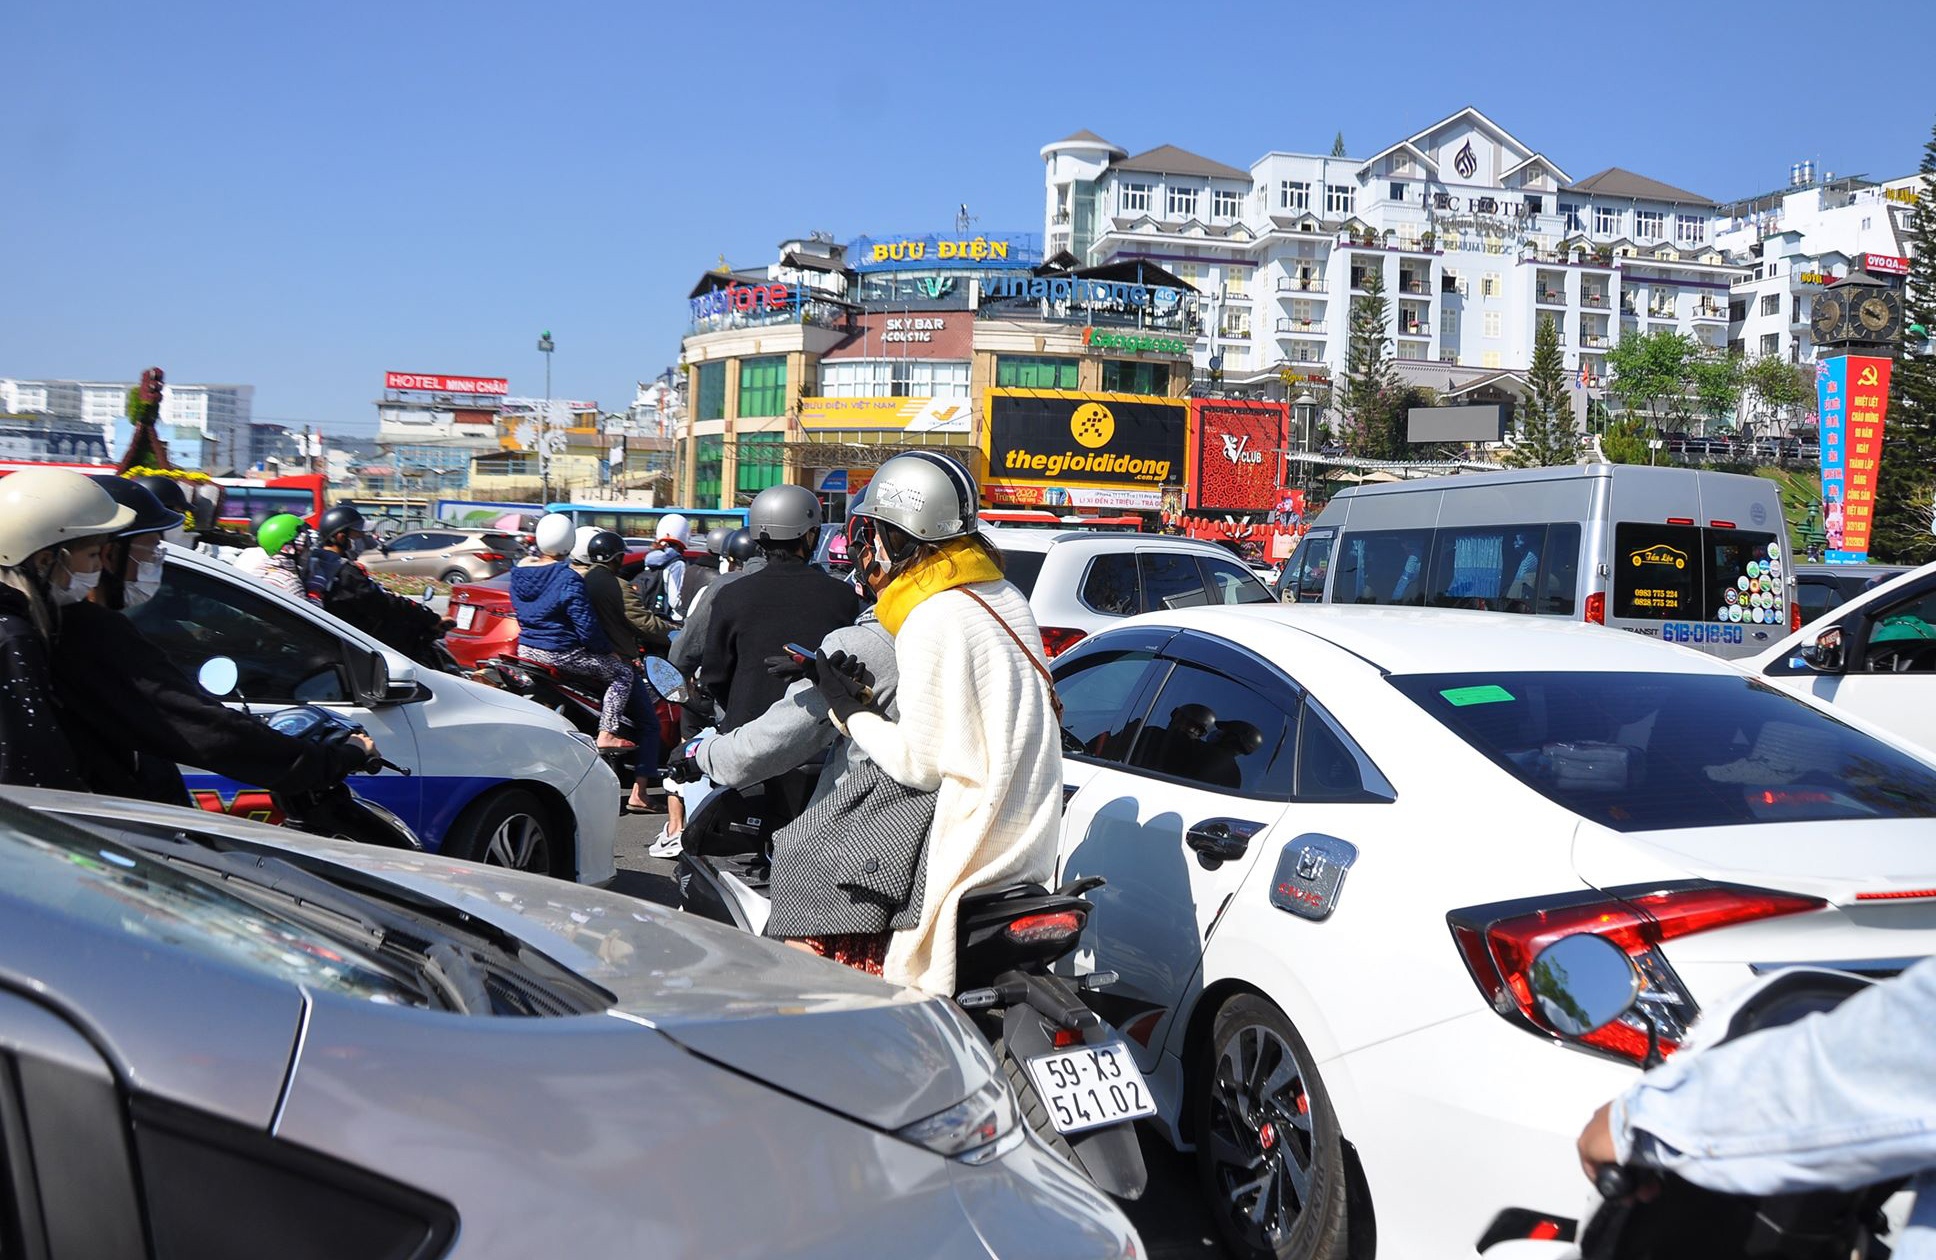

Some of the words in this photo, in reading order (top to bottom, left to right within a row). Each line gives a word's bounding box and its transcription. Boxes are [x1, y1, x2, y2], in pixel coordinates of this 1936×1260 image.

[873, 241, 925, 262] BƯU
[937, 236, 1009, 262] ĐIỆN
[1868, 256, 1886, 267] OYO
[981, 275, 1147, 306] vinaphone
[1157, 290, 1173, 300] 4G
[886, 319, 912, 331] SKY
[914, 318, 945, 331] BAR
[389, 374, 444, 389] HOTEL
[446, 379, 476, 392] MINH
[804, 402, 823, 410] BƯU
[851, 400, 871, 410] VIỆT
[1241, 451, 1263, 463] CLUB
[1006, 450, 1170, 481] thegioididong
[1653, 590, 1665, 598] 775
[1666, 590, 1678, 598] 224
[1739, 594, 1749, 606] 61
[1653, 599, 1665, 607] 775
[1666, 599, 1678, 607] 224
[1045, 1049, 1122, 1089] 59-X3
[1052, 1081, 1148, 1126] 541.02
